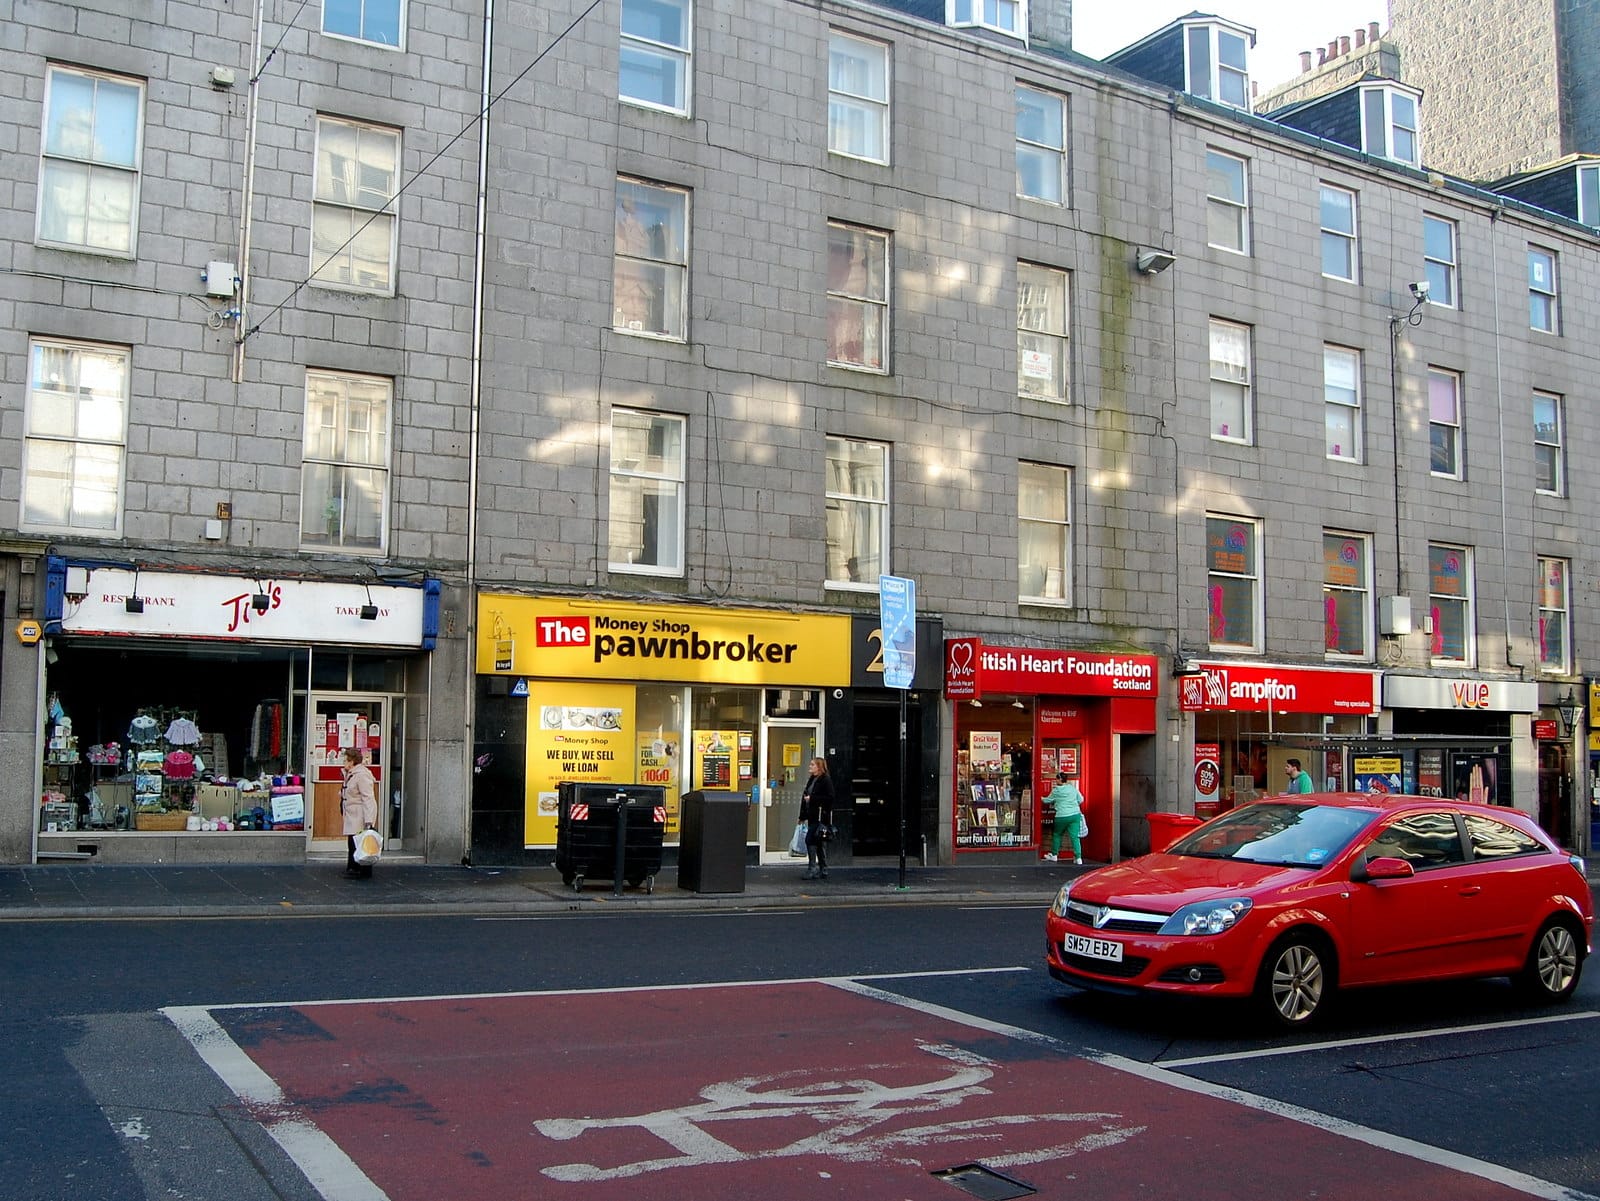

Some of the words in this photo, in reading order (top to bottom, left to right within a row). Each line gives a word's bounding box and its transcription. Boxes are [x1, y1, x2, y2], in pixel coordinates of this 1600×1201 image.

[540, 620, 587, 643] The
[594, 615, 648, 634] Money
[651, 619, 690, 635] Shop
[594, 632, 798, 663] pawnbroker
[980, 652, 1017, 671] itish
[1020, 654, 1064, 674] Heart
[1067, 656, 1151, 678] Foundation
[1112, 678, 1151, 691] Scotland
[1229, 679, 1296, 703] amplifon
[564, 737, 588, 745] Money
[590, 737, 609, 745] Shop
[546, 750, 560, 760] WE
[562, 750, 580, 761] BUY,
[581, 751, 595, 761] WE
[596, 751, 615, 761] SELL
[562, 762, 576, 773] WE
[577, 763, 599, 773] LOAN
[973, 833, 983, 843] FOR
[1067, 935, 1091, 953] SW57
[1093, 940, 1118, 958] EBZ
